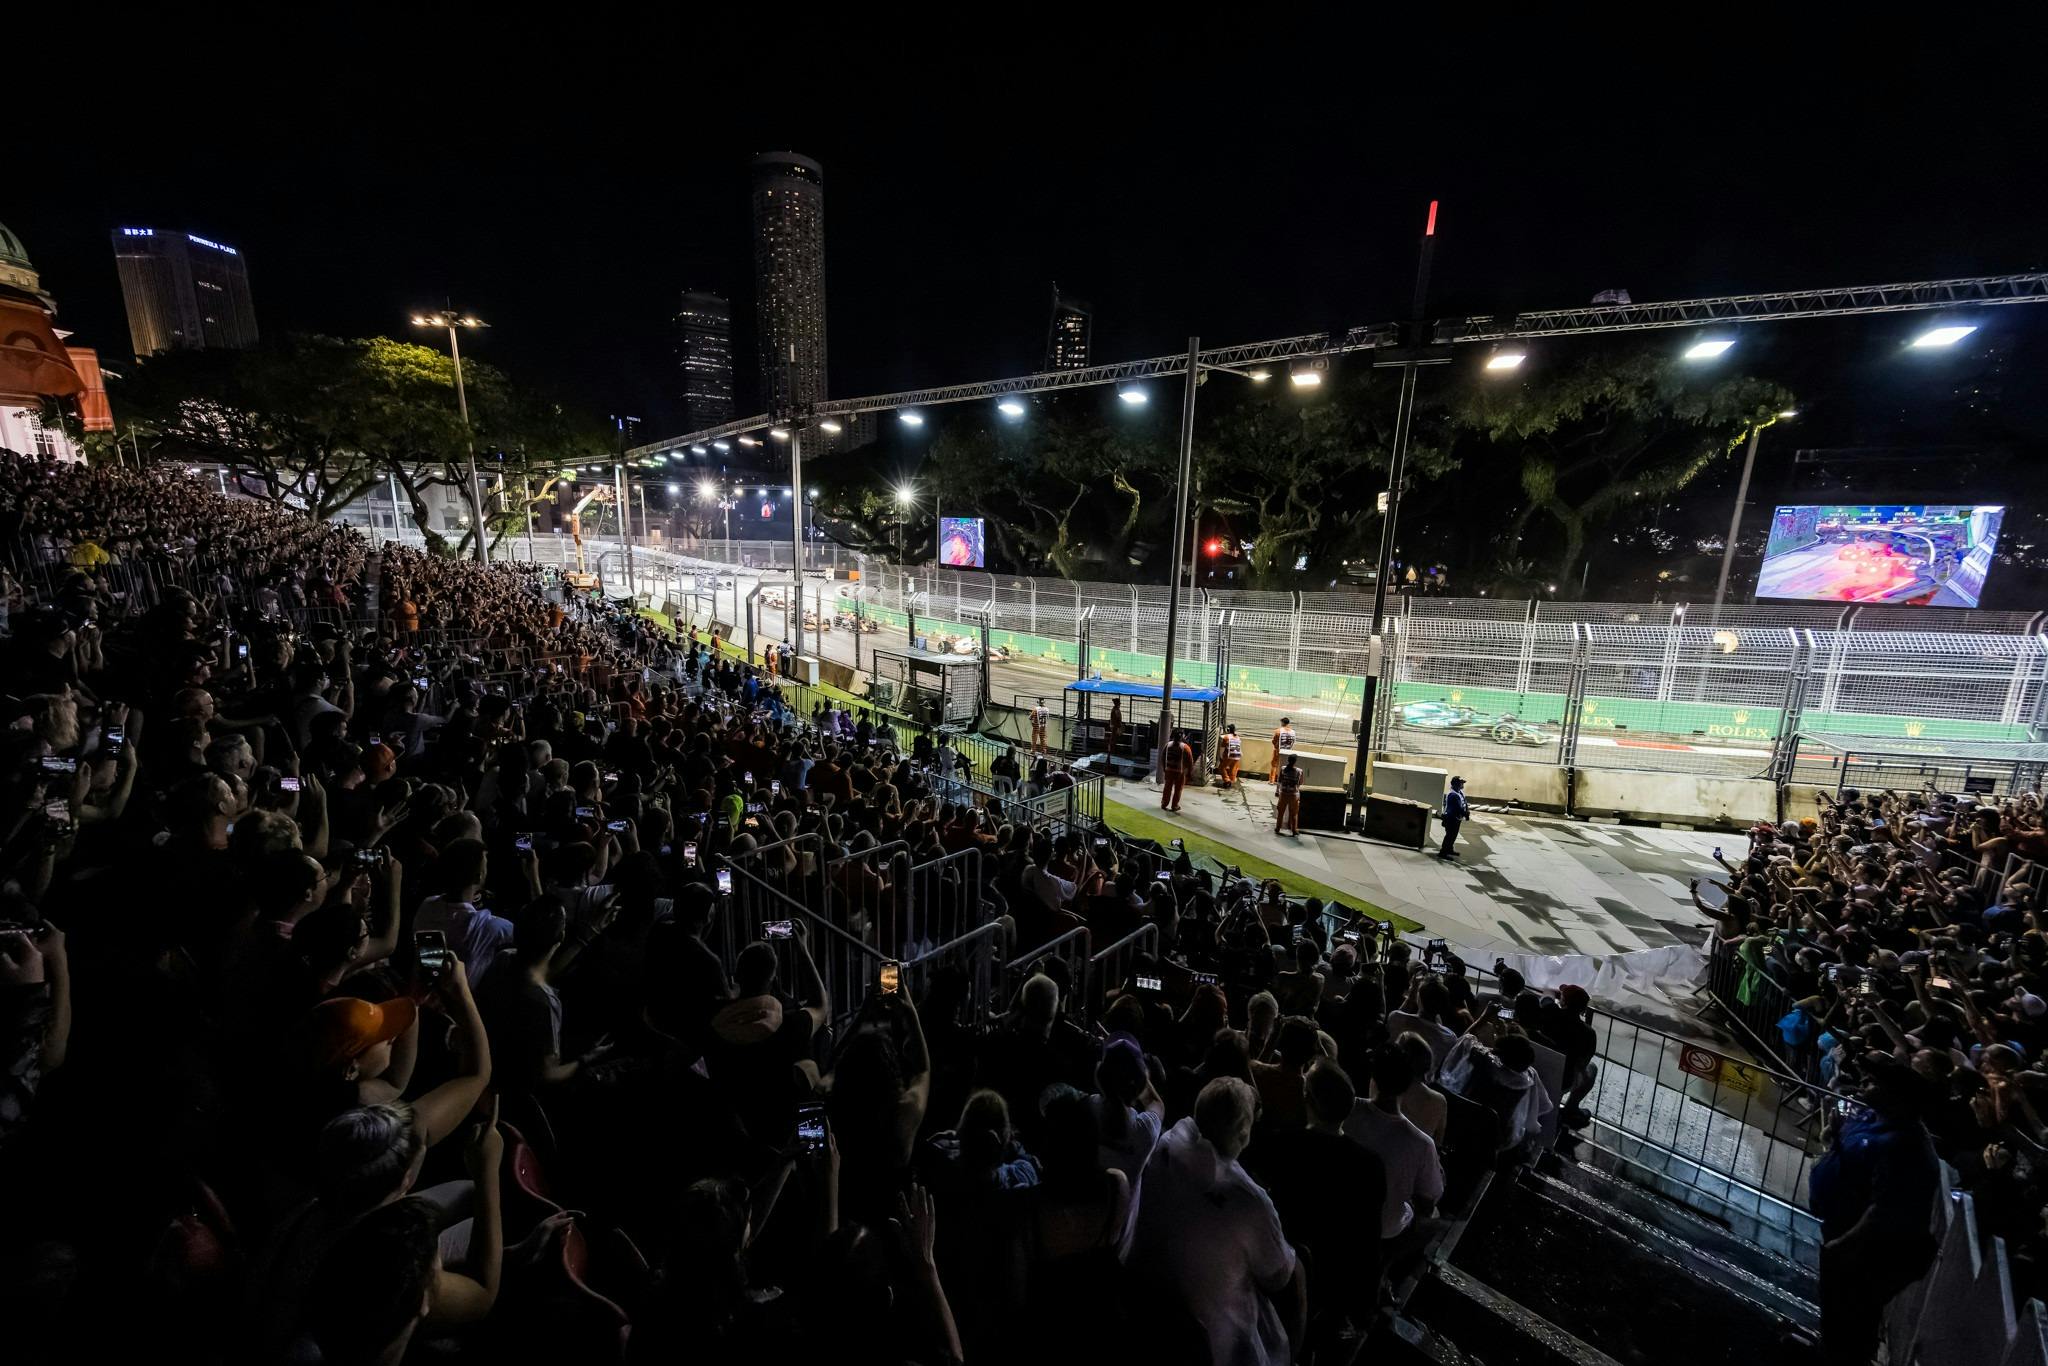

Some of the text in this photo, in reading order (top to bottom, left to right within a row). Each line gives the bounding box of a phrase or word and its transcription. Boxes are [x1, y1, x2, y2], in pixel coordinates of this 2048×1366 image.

[188, 234, 237, 255] PENINSULA PLAZA
[1321, 689, 1361, 703] ROLEX
[1562, 714, 1616, 728] RLEX
[1709, 724, 1769, 739] ROLEX
